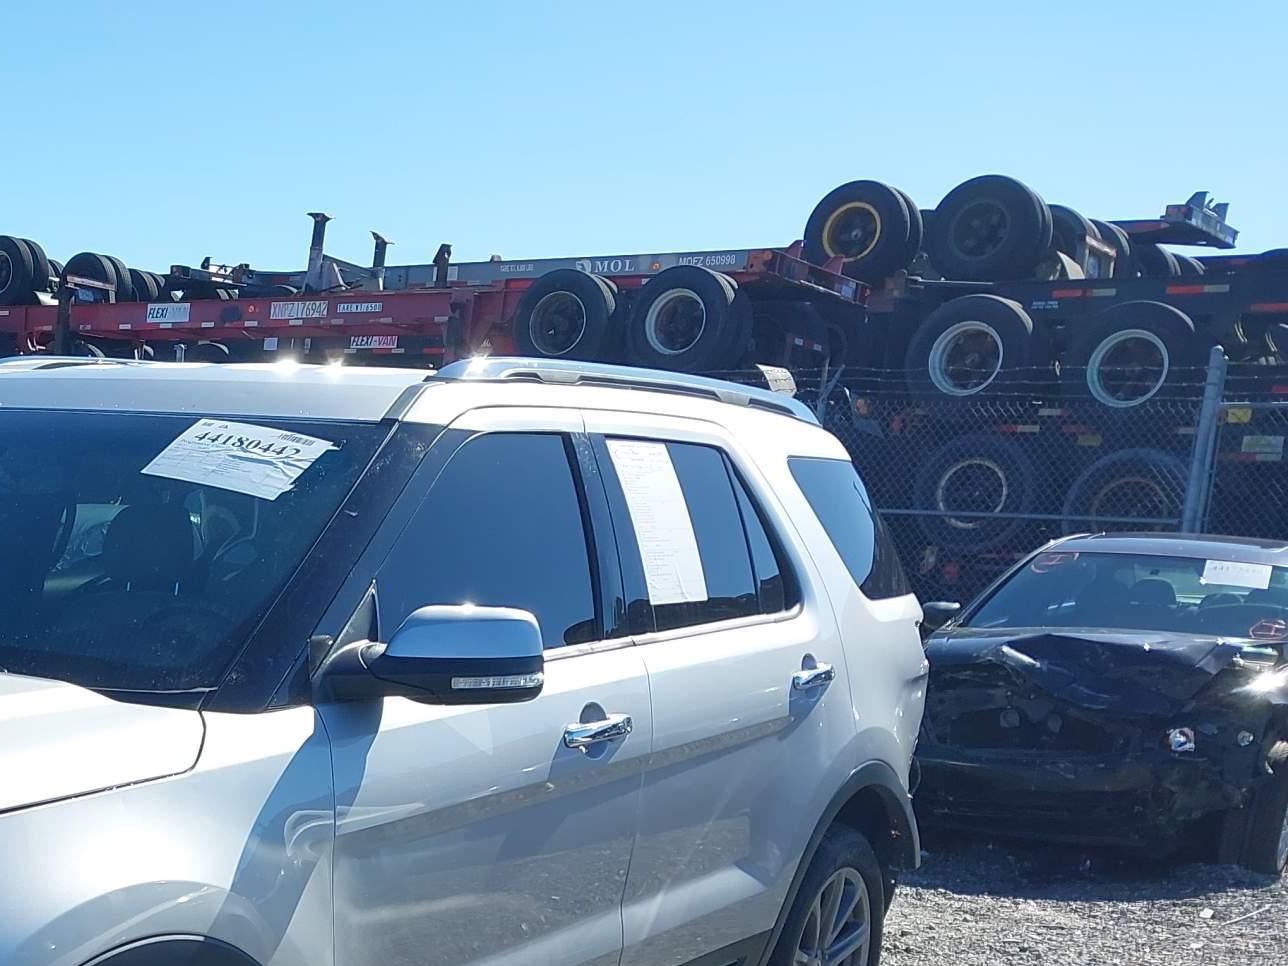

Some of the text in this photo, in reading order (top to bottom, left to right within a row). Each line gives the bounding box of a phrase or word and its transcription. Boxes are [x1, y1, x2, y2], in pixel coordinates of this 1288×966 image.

[594, 260, 634, 273] MOL
[148, 307, 169, 319] FLEXI
[195, 431, 302, 458] 44180442
